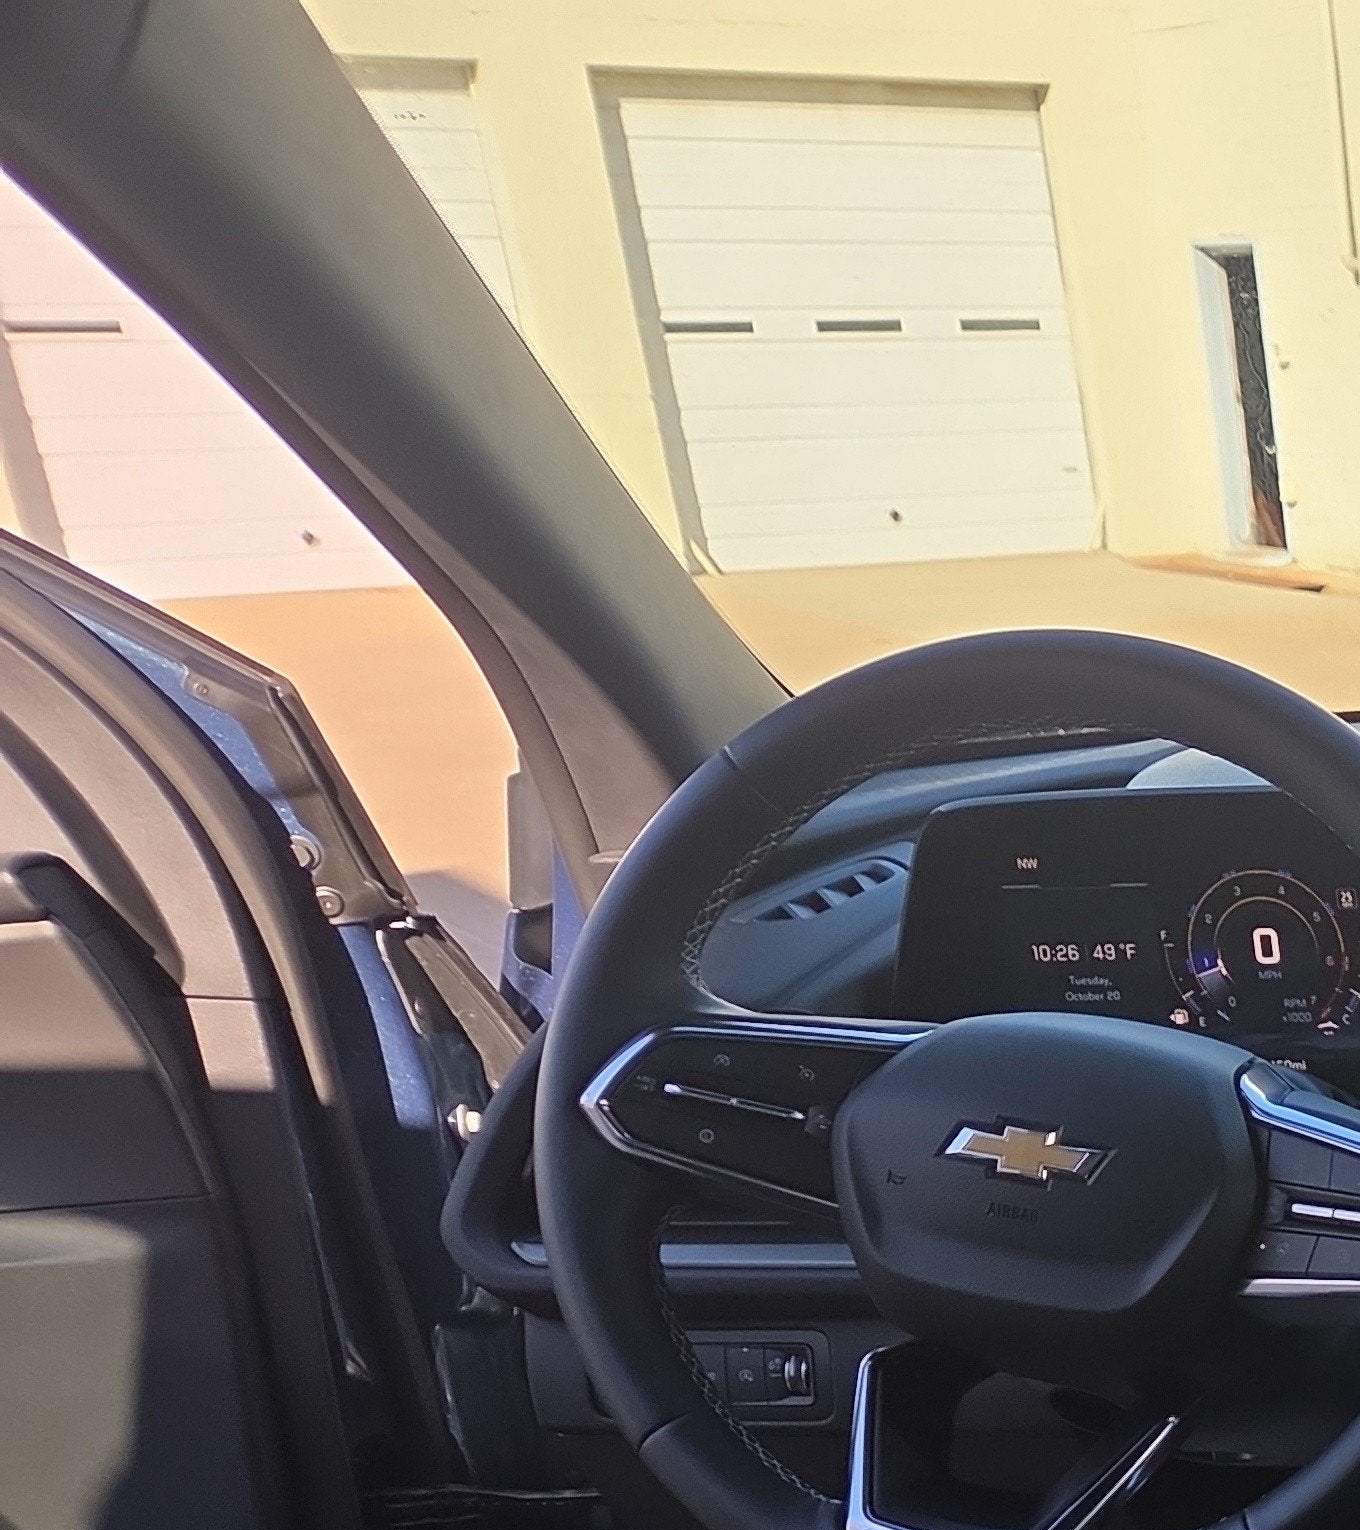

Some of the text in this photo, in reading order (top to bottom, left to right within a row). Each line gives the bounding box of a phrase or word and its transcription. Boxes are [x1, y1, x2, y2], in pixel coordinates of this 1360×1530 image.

[1016, 857, 1038, 869] NW
[1252, 927, 1281, 965] 0
[1031, 944, 1080, 962] 10:26
[1258, 970, 1283, 980] MPH
[1065, 991, 1105, 1002] October
[1283, 998, 1307, 1010] RPM
